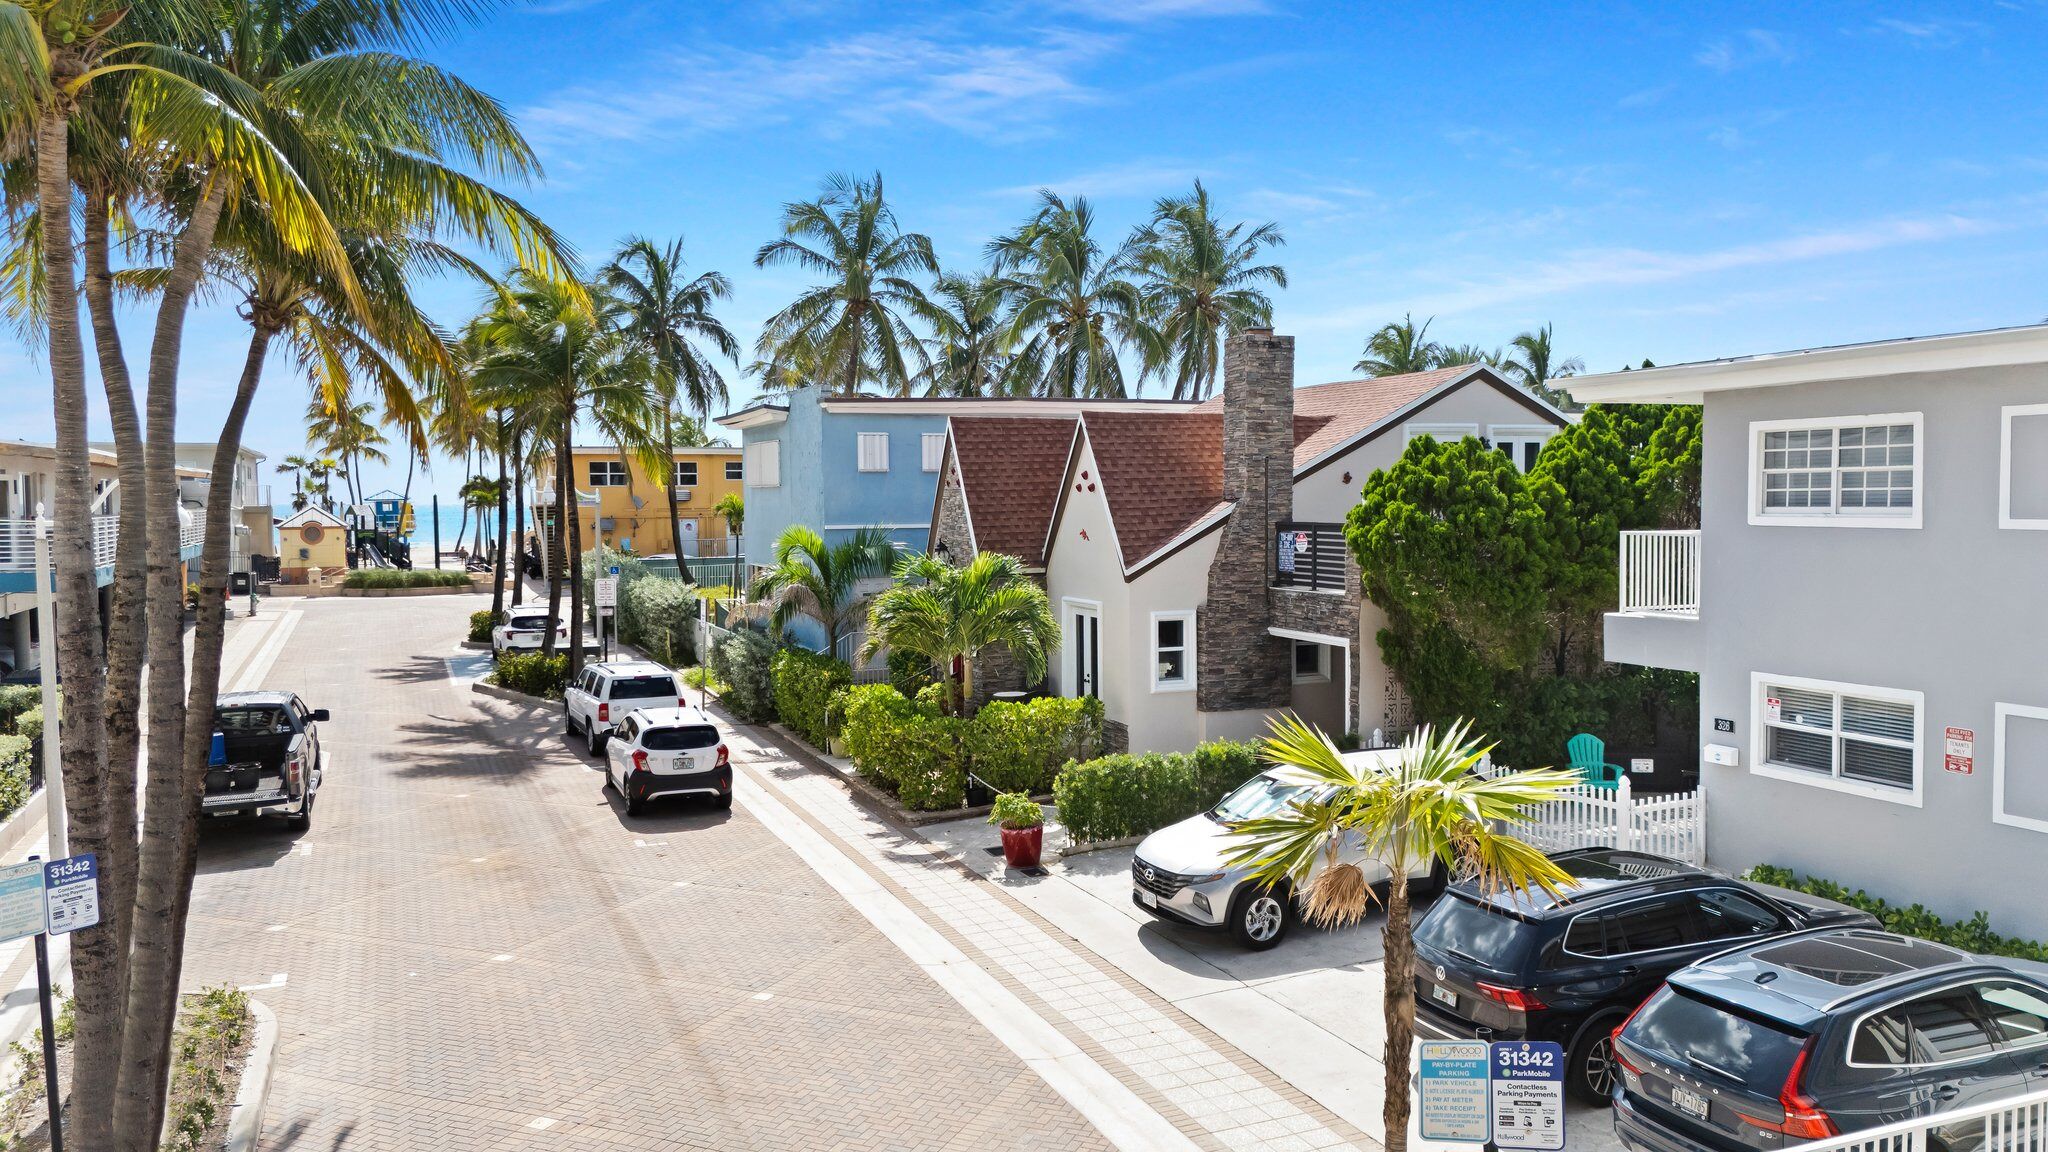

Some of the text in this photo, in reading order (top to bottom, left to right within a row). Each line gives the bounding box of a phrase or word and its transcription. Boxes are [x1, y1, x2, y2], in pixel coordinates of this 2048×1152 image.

[50, 861, 90, 878] 31342
[1498, 1051, 1554, 1067] 31342
[1512, 1070, 1551, 1078] ParkMobile
[1650, 1061, 1719, 1095] VOLVO
[1497, 1090, 1558, 1099] Parking Payments
[1497, 1133, 1525, 1141] Hollywood
